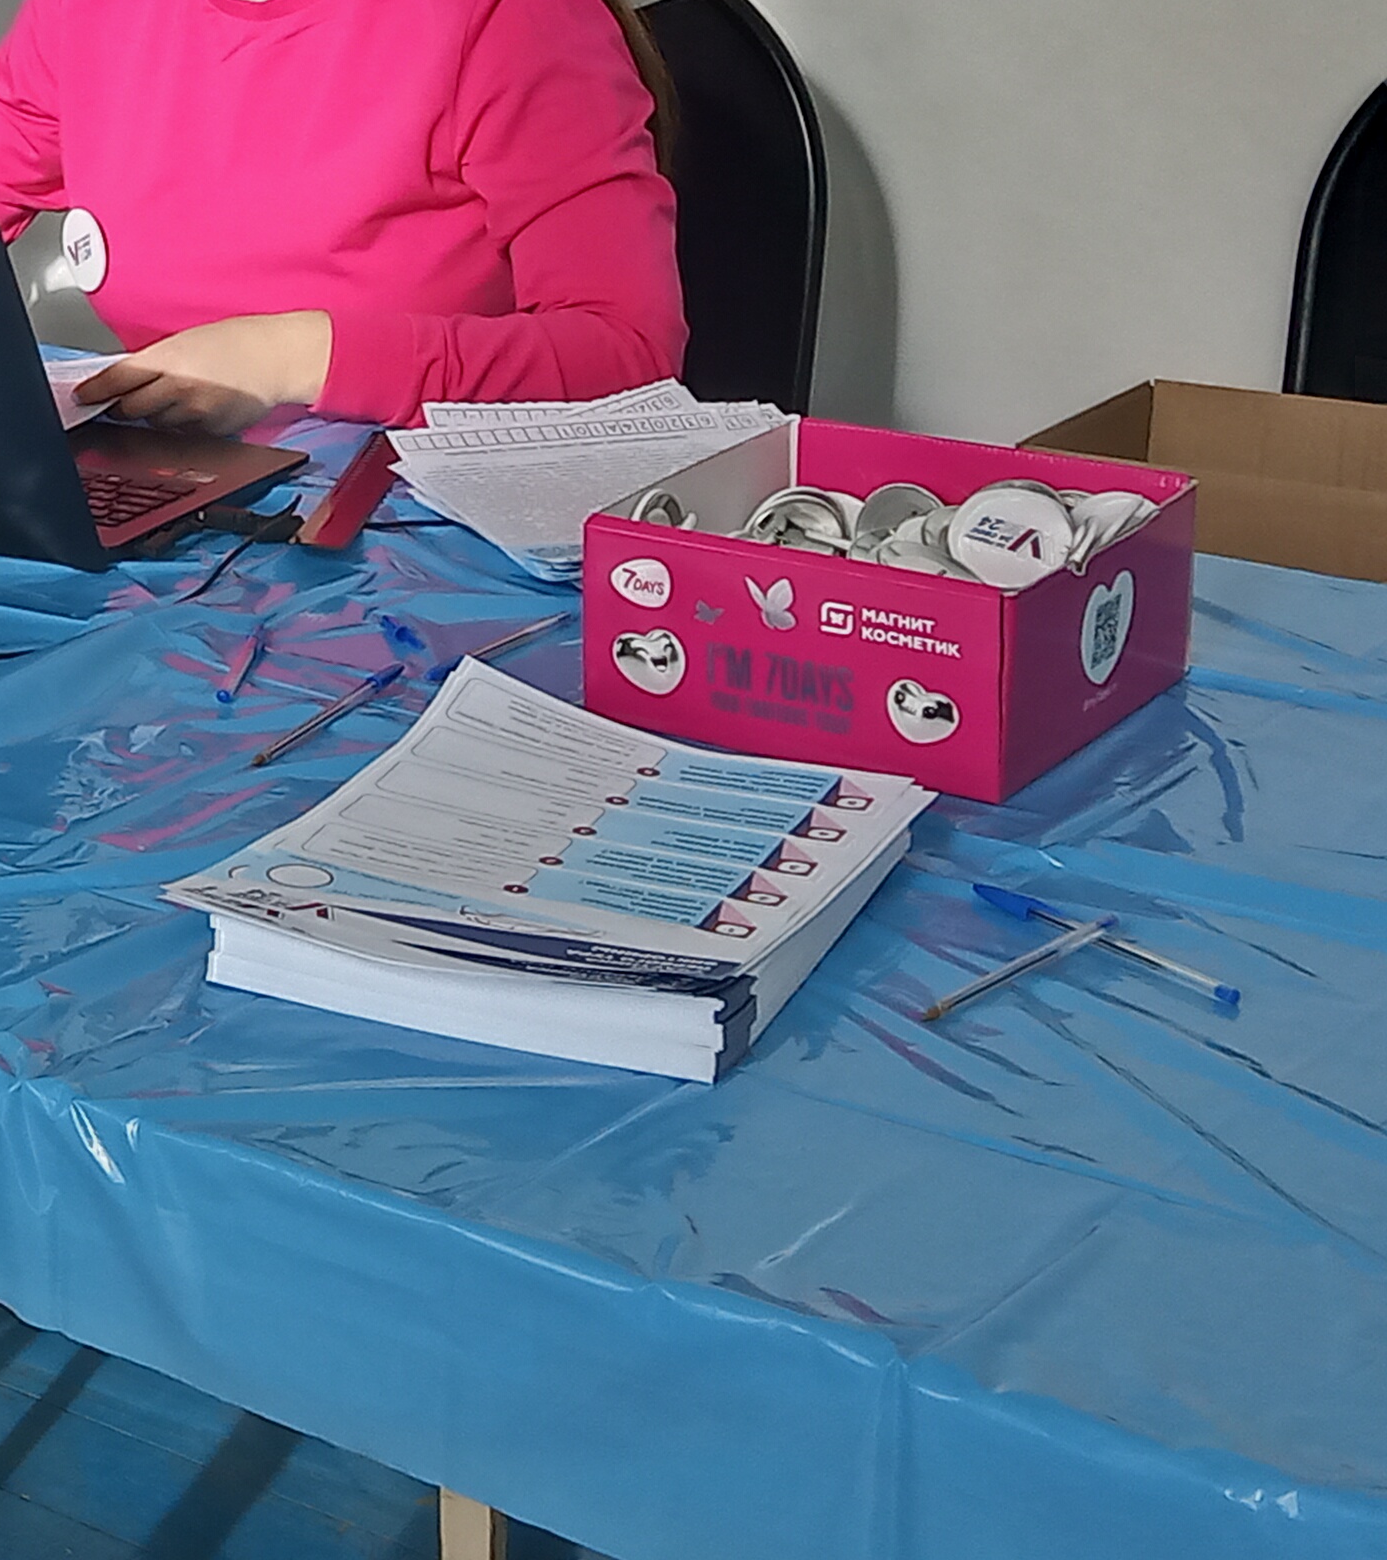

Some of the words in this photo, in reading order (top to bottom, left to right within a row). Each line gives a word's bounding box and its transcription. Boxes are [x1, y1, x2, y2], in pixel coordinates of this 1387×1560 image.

[621, 567, 666, 597] 7DAYS
[860, 607, 936, 634] МАГНИТ
[860, 626, 962, 659] КОСМЕТИК
[764, 651, 855, 712] 7DAYS
